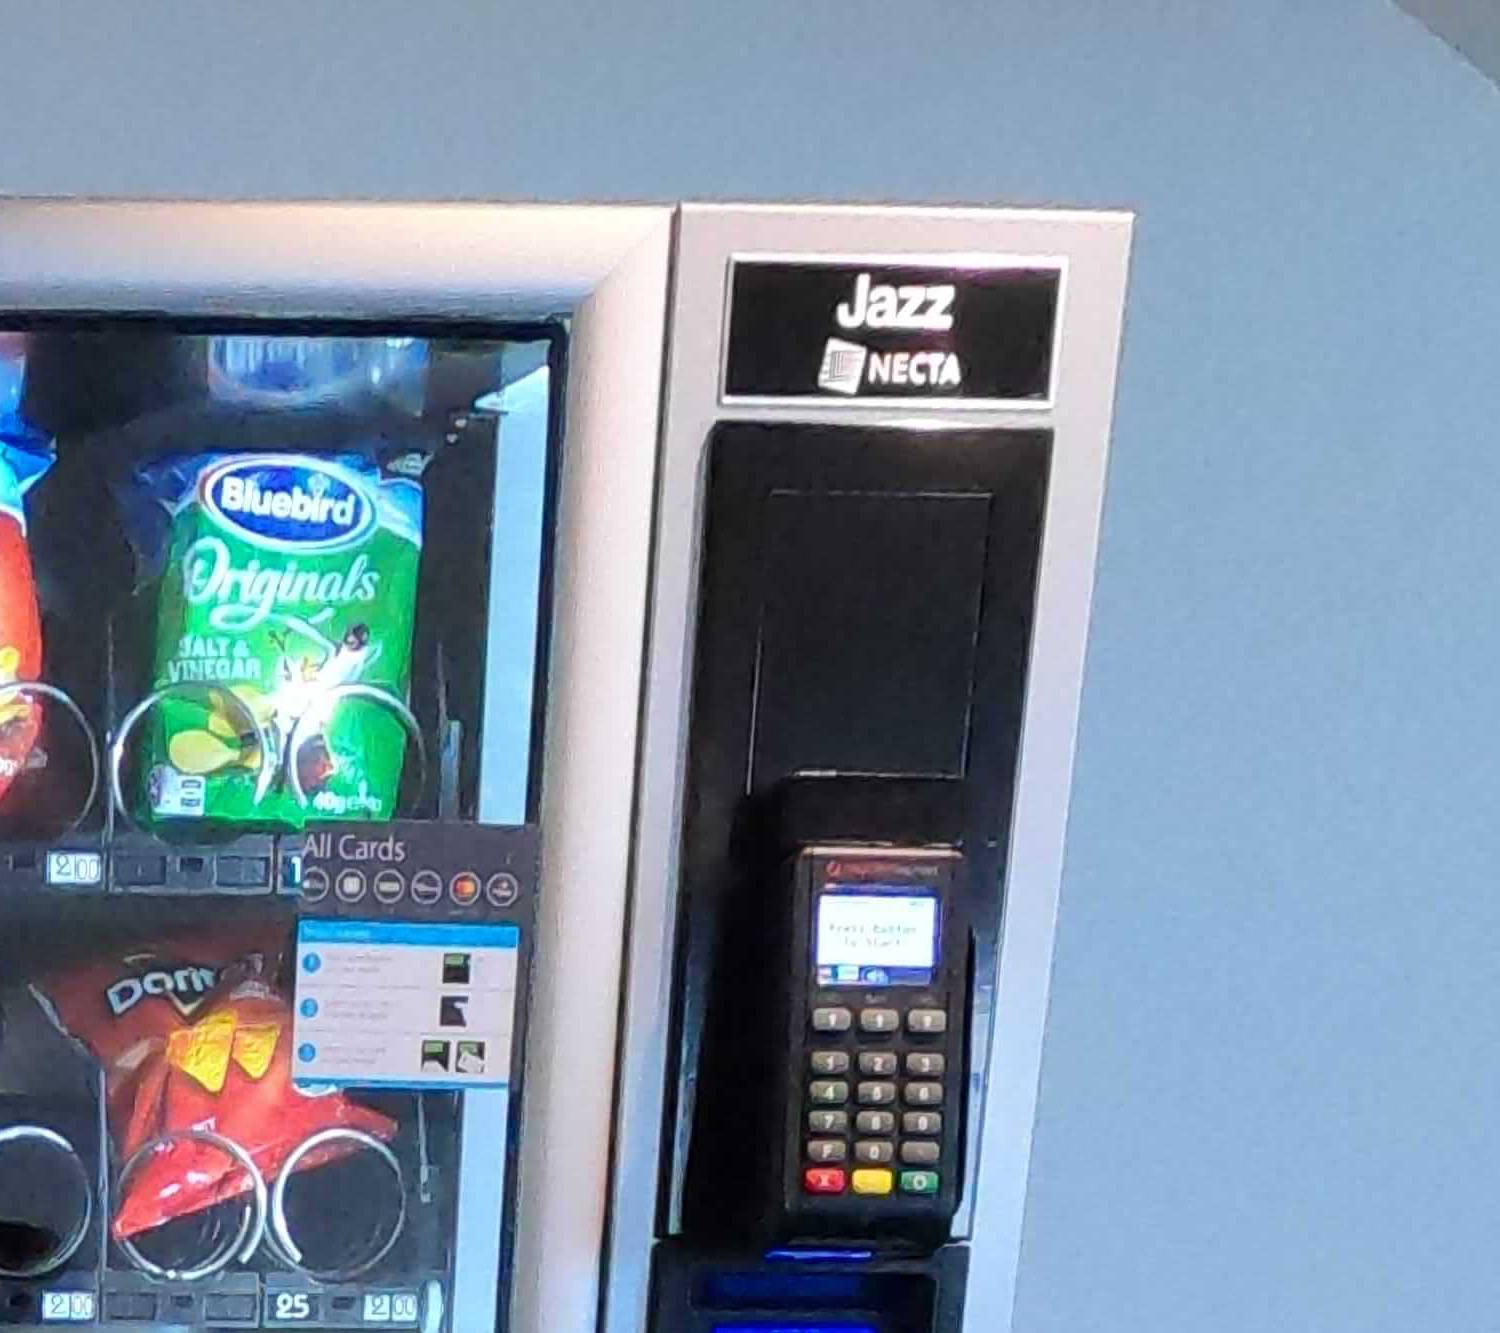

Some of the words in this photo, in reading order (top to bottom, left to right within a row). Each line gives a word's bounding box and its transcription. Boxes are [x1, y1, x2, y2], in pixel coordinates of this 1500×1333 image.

[836, 273, 956, 329] Jazz
[868, 352, 962, 385] NECTA
[220, 475, 356, 527] Bluebird
[183, 537, 379, 628] Originals
[179, 634, 228, 658] SALT
[167, 656, 261, 683] VINEGAR
[301, 833, 332, 859] All
[338, 834, 406, 862] Cards
[275, 1293, 310, 1318] 25
